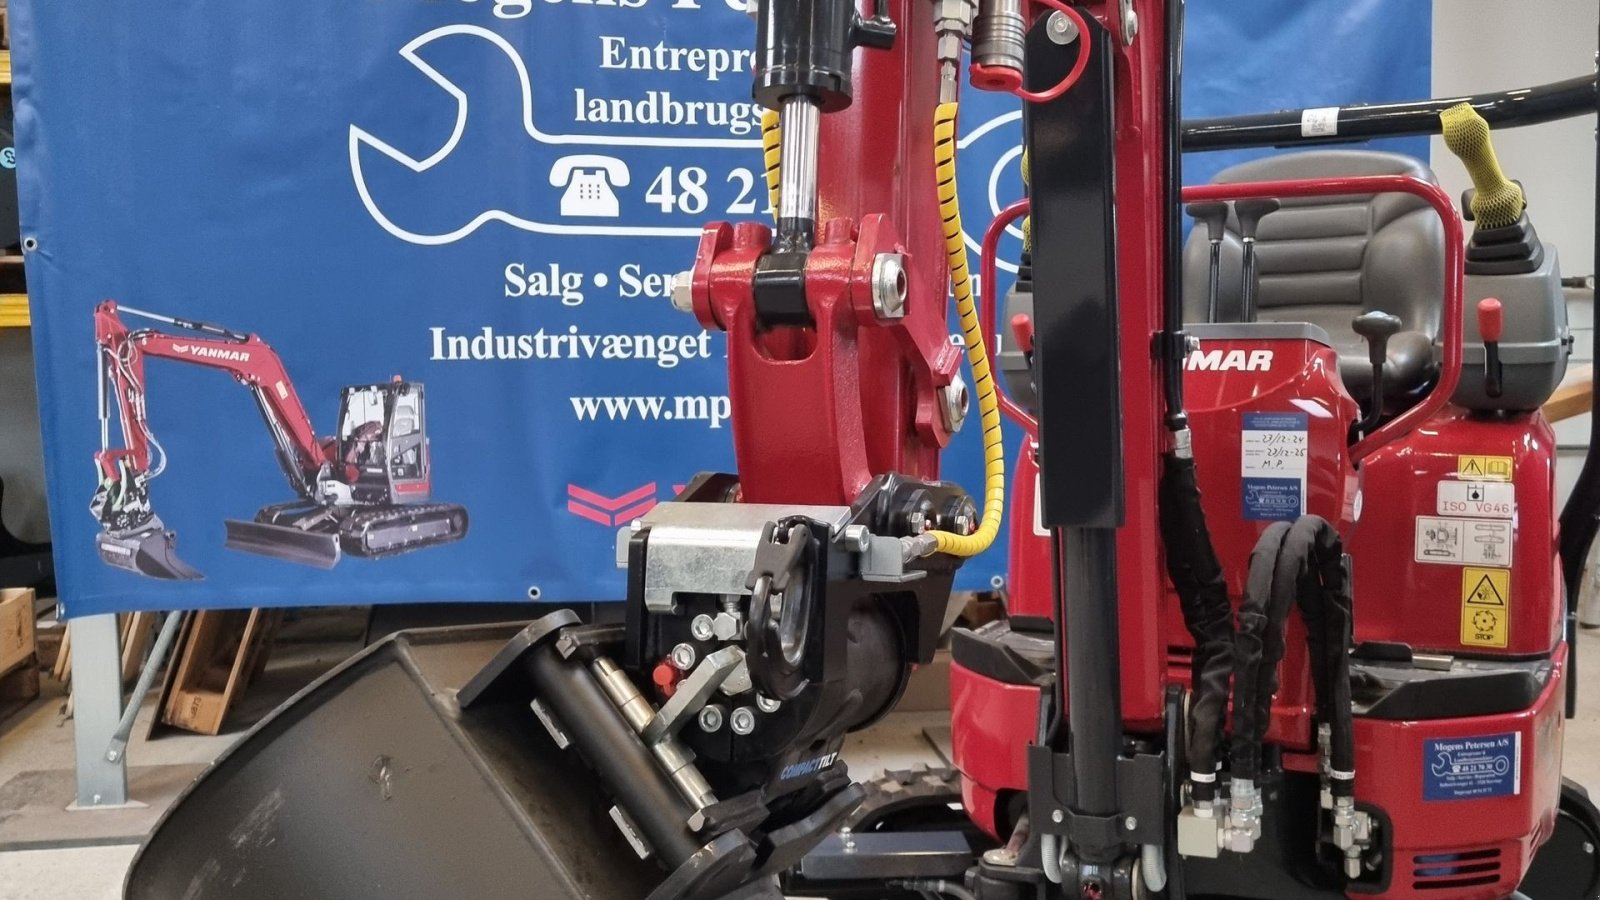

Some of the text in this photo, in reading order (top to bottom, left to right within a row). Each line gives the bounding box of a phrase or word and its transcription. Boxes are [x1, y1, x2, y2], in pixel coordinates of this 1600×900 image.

[645, 166, 709, 214] 48
[504, 263, 584, 306] Salg
[190, 345, 250, 362] YANMAR
[429, 325, 712, 368] Industrivænget
[1182, 350, 1273, 371] MAR
[1443, 501, 1510, 513] ISO VG46
[1465, 741, 1496, 750] Petersen
